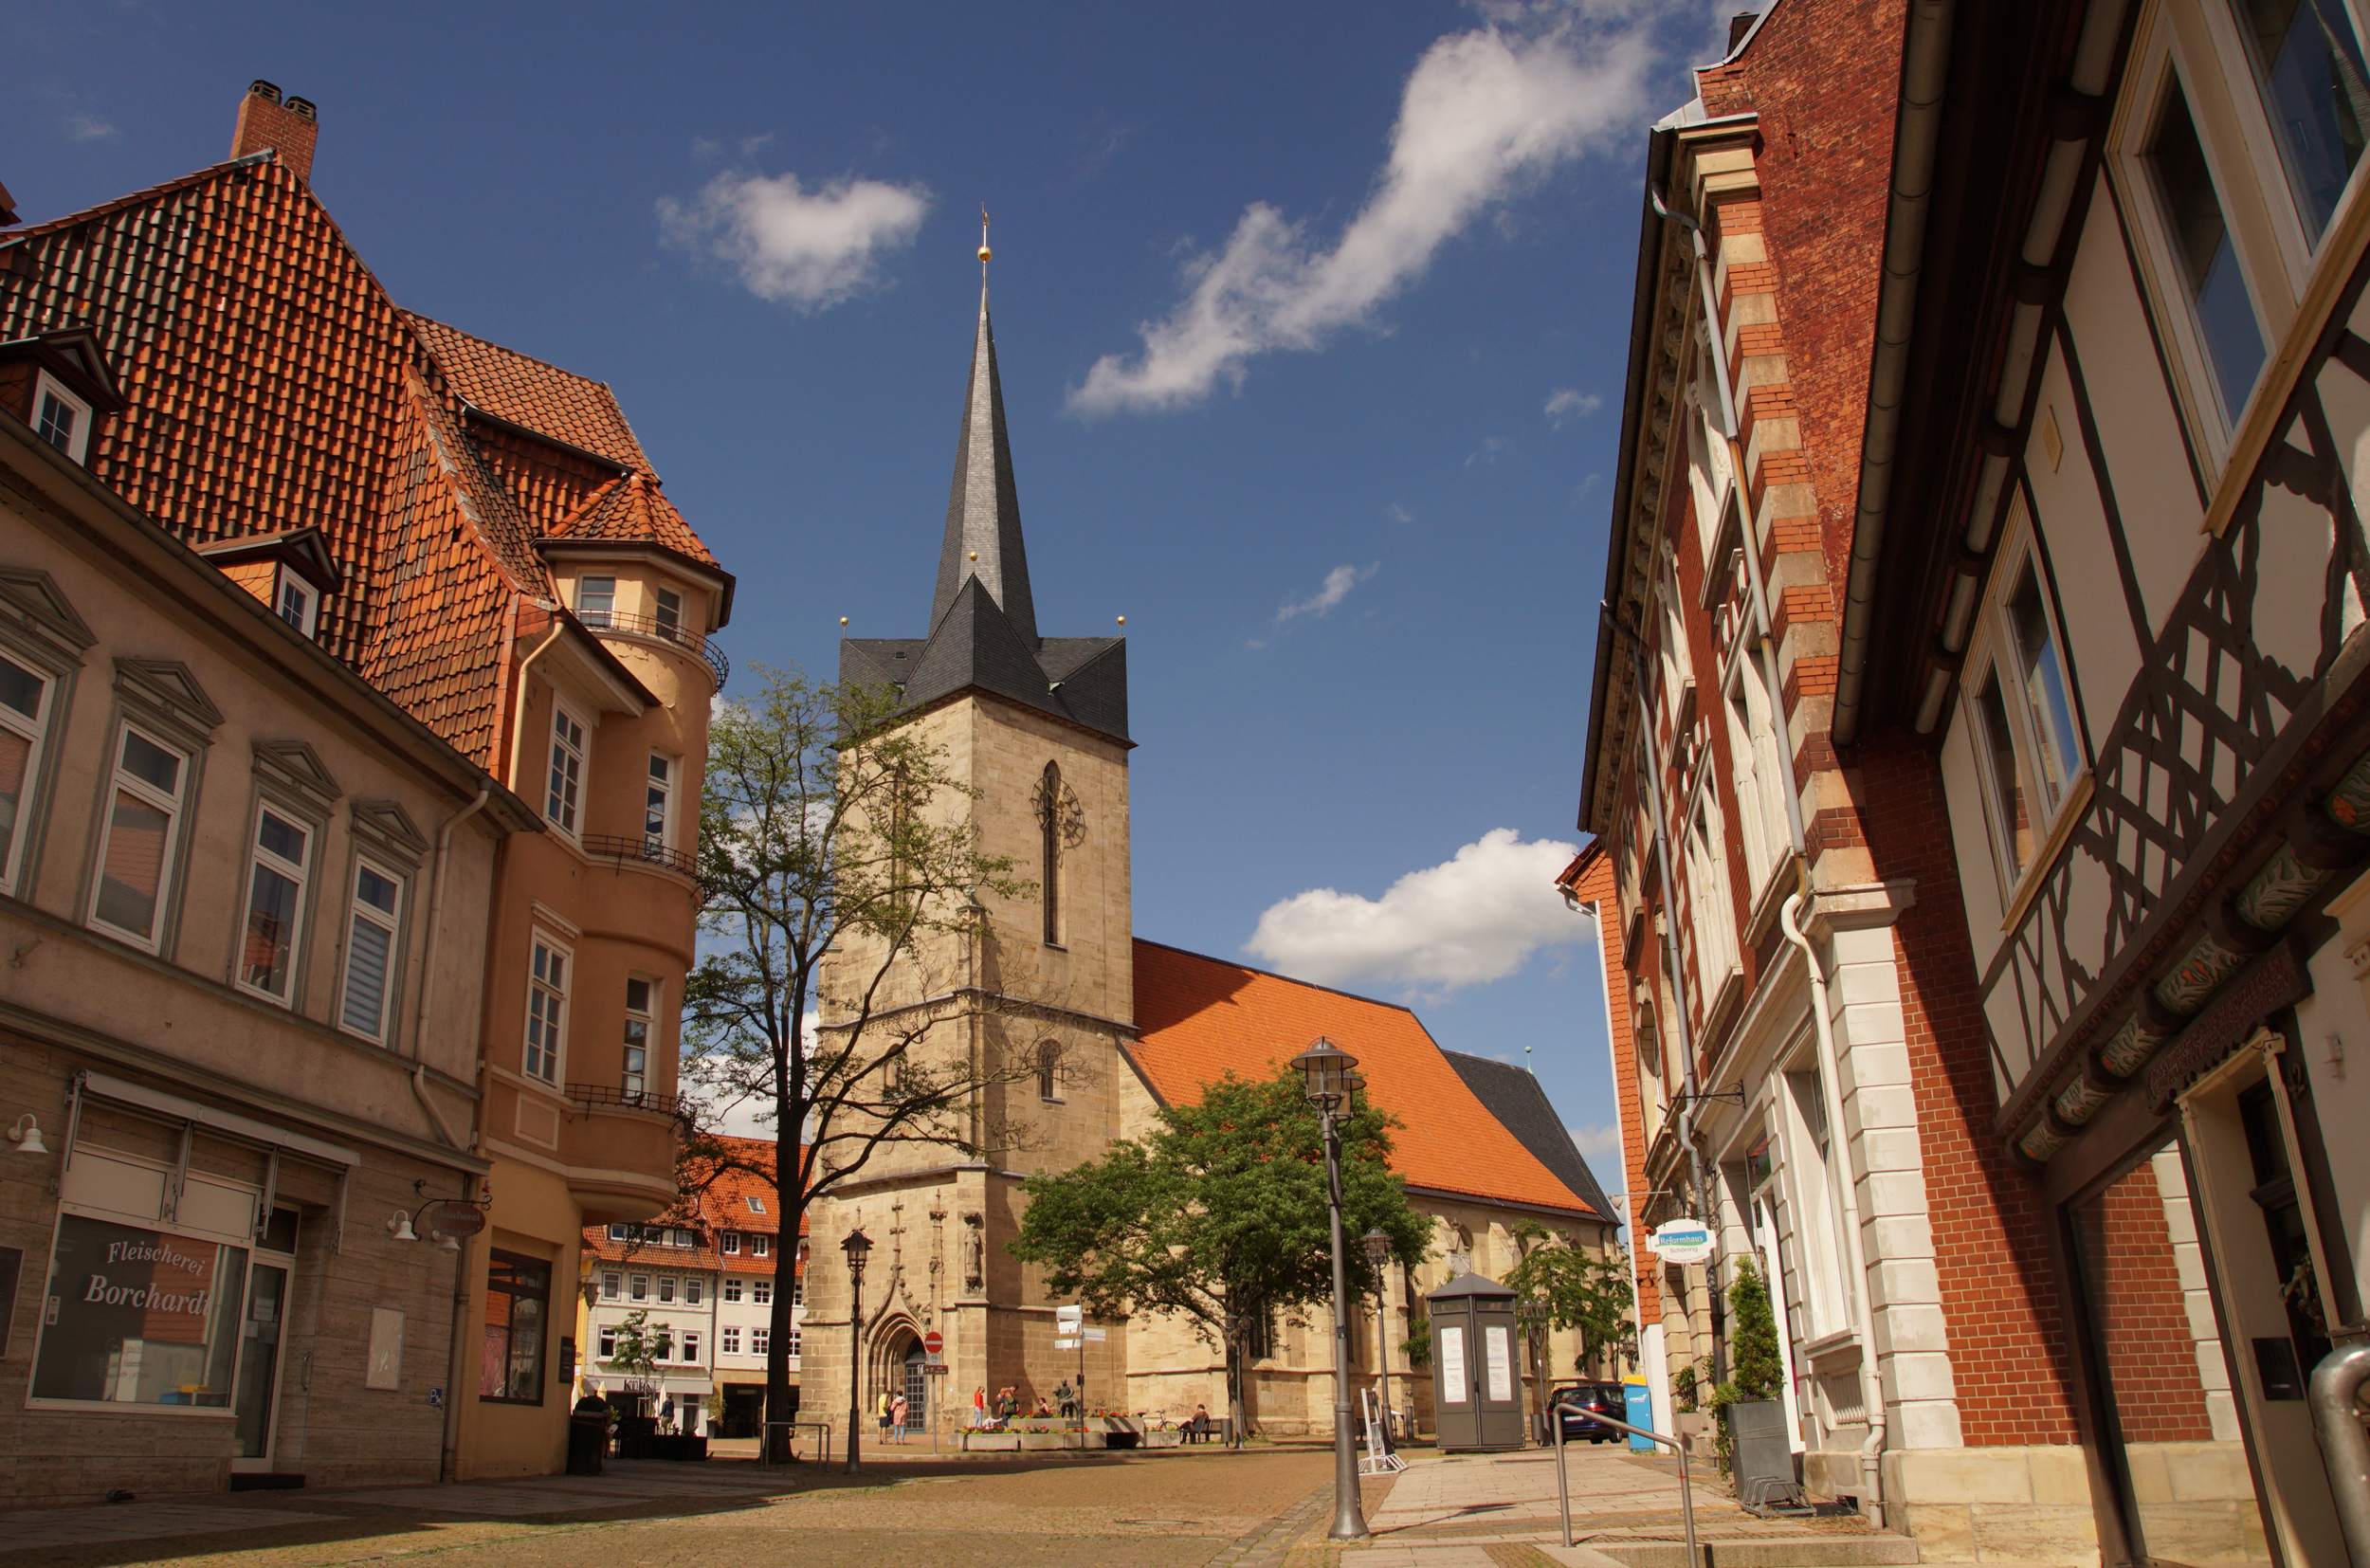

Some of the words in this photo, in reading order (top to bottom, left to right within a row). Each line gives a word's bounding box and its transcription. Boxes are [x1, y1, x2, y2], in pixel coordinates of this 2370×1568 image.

[107, 1240, 206, 1276] Fleischerei
[1660, 1235, 1704, 1245] Reformhaus
[83, 1274, 211, 1316] Borchardt
